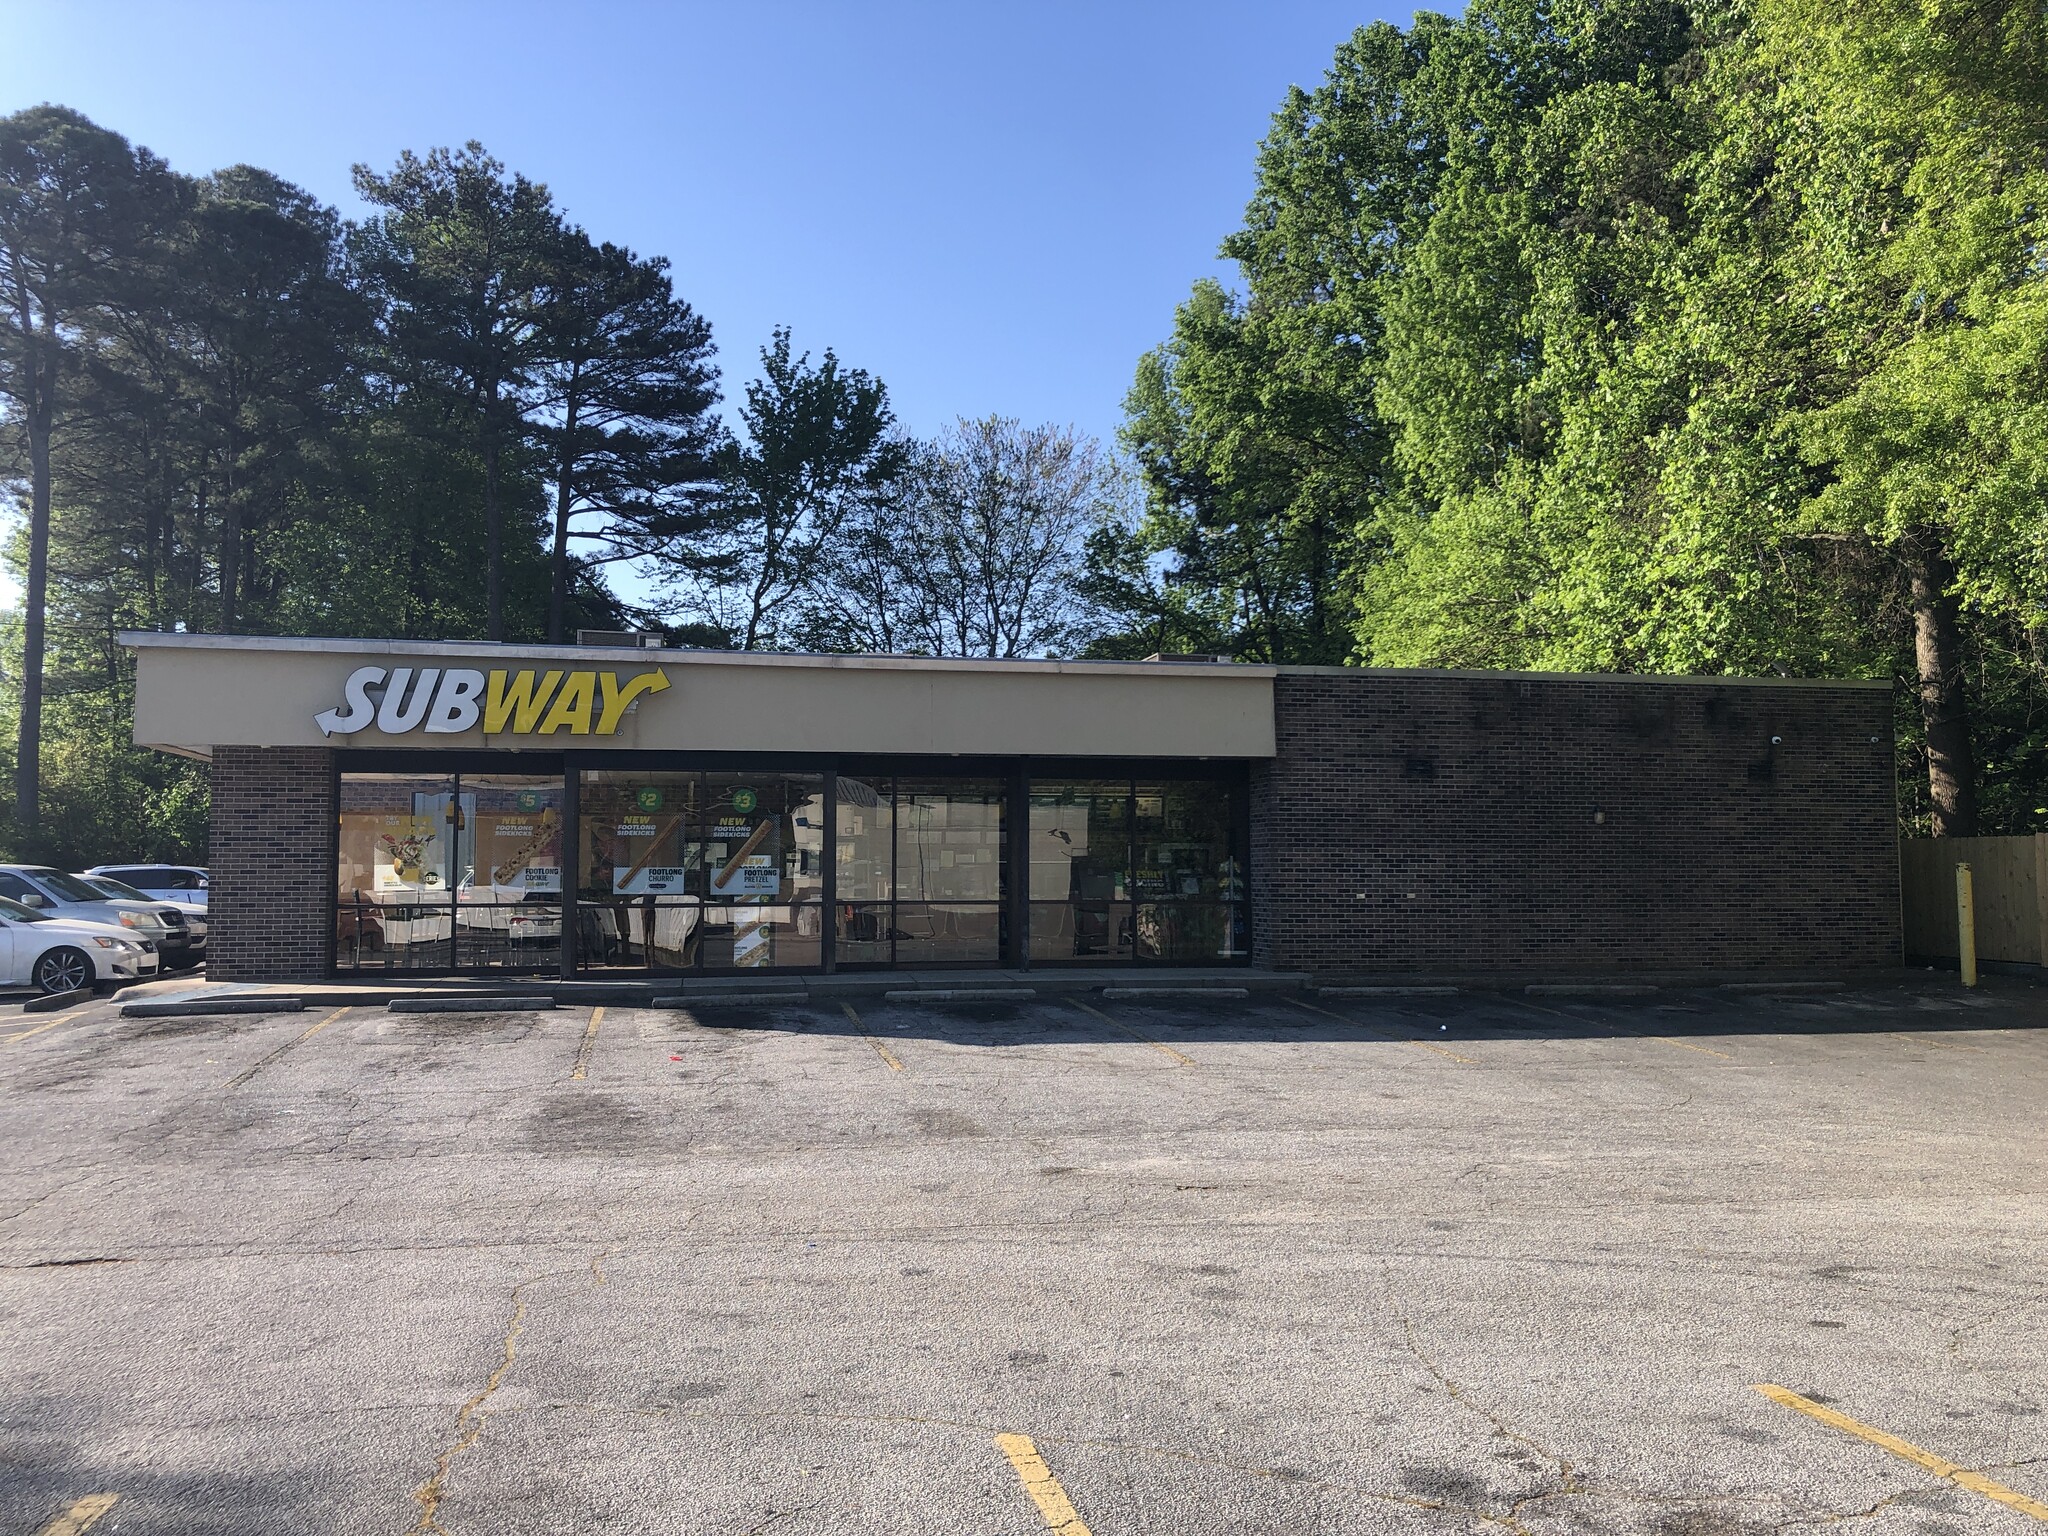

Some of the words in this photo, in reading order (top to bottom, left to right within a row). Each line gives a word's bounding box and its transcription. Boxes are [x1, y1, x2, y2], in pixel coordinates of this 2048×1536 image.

[313, 666, 672, 738] SUBWAY
[521, 793, 536, 807] $5
[641, 793, 657, 806] $2
[735, 794, 751, 808] $3
[502, 816, 528, 825] NEW
[623, 815, 651, 824] NEW
[719, 817, 746, 826] NEW
